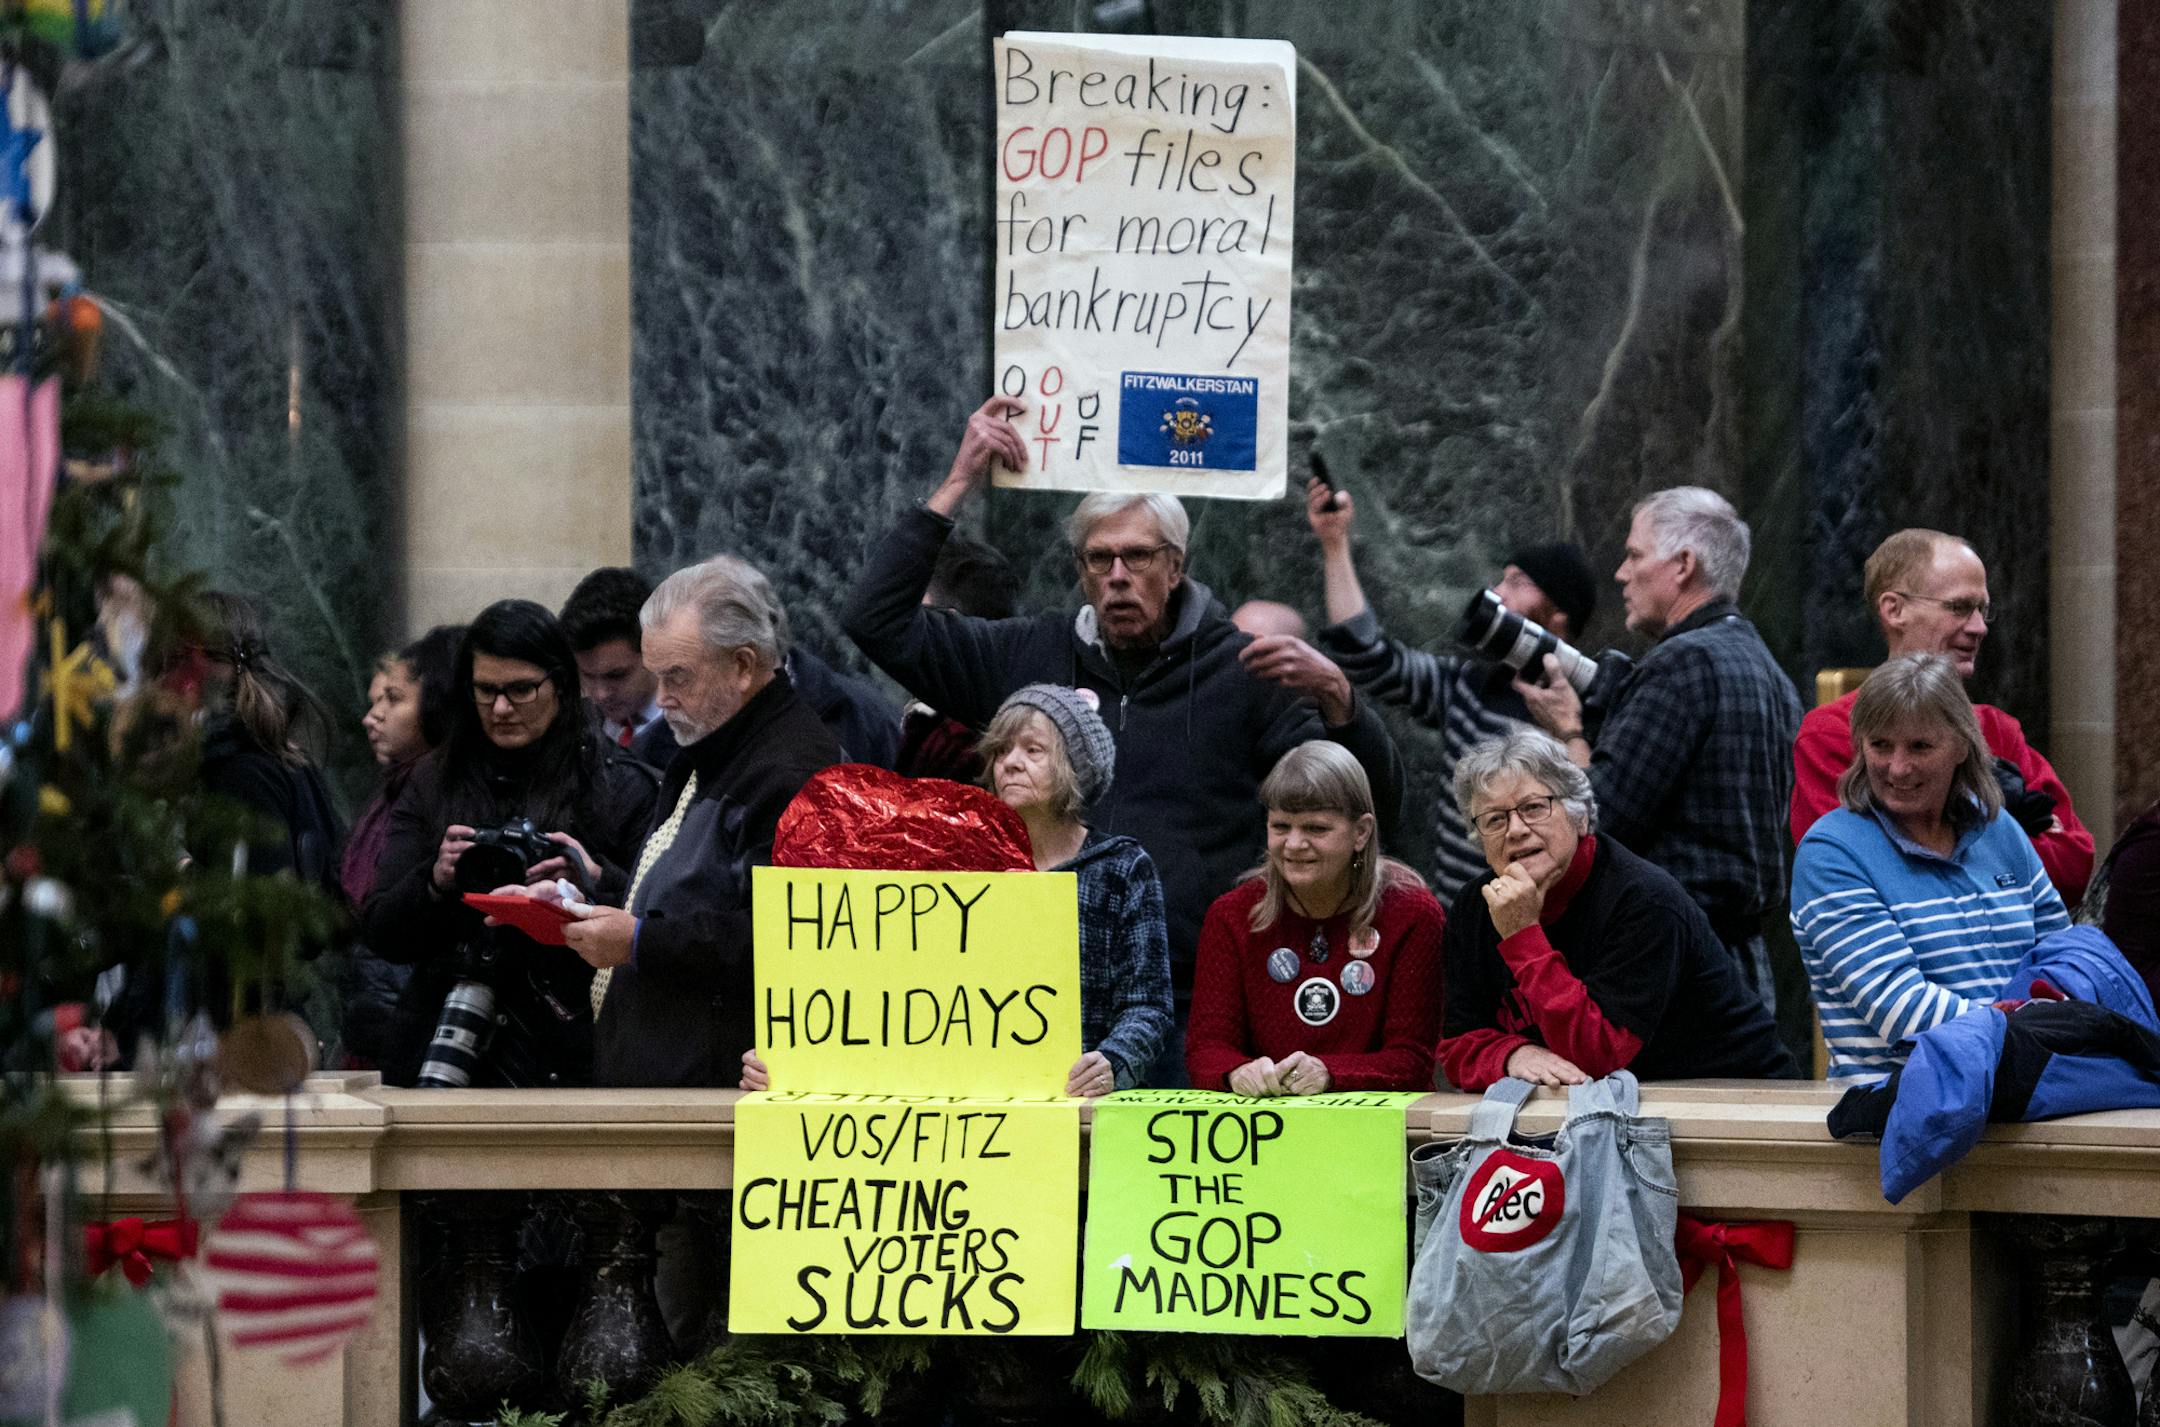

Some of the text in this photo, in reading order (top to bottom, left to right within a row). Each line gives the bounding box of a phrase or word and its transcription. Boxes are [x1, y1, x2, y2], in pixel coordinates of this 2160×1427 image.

[1005, 48, 1271, 133] Breaking:
[1002, 126, 1262, 196] GOP files
[998, 190, 1275, 255] for moral
[1003, 266, 1272, 368] bankruptcy
[1123, 374, 1254, 395] FITZWALKERSTAN
[1169, 449, 1204, 465] 2011
[787, 881, 991, 953] HAPPY
[766, 985, 1057, 1049] HOLIDAYS
[801, 1107, 1011, 1166] VOS/FITZ
[1147, 1109, 1284, 1166] STOP
[739, 1177, 970, 1232] CHEATING
[1159, 1173, 1244, 1205] THE
[844, 1228, 1020, 1275] VOTERS
[1150, 1211, 1282, 1269] GOP
[786, 1265, 1026, 1334] SUCKS
[1114, 1265, 1373, 1325] MADNESS
